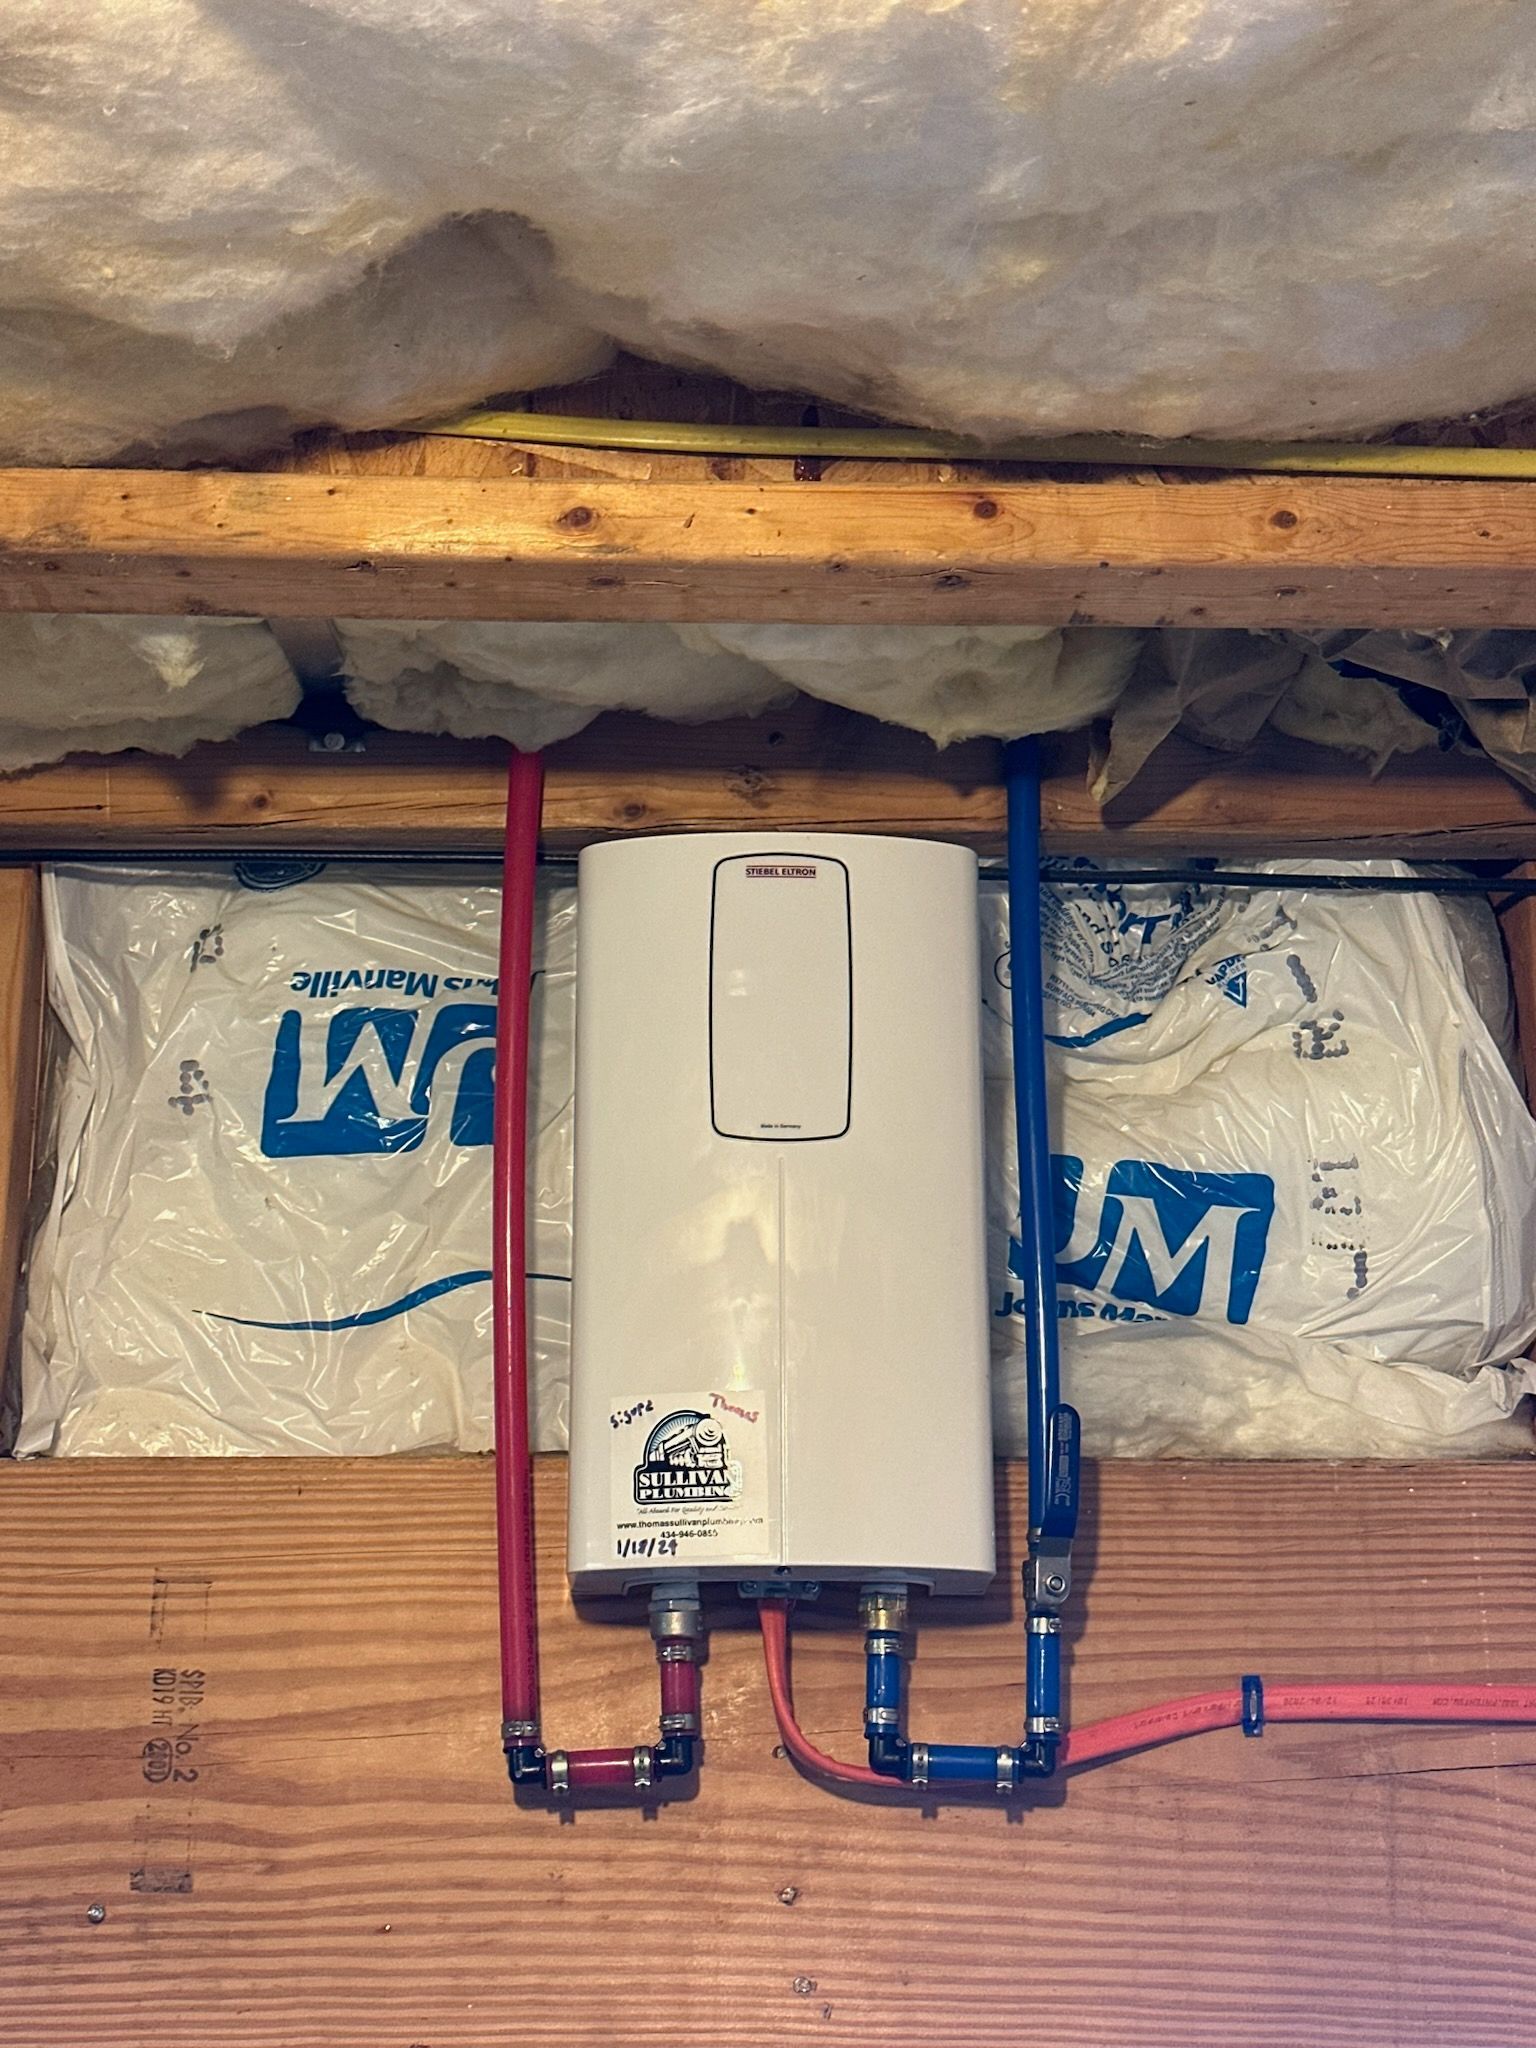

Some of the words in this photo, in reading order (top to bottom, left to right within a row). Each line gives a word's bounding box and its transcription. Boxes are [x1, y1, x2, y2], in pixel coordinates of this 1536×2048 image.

[745, 868, 780, 876] STIEBEL
[782, 868, 816, 876] ELTRON
[290, 969, 438, 998] Manville
[995, 1291, 1096, 1319] Jons
[152, 1668, 177, 1705] KD19
[152, 1710, 173, 1727] HT
